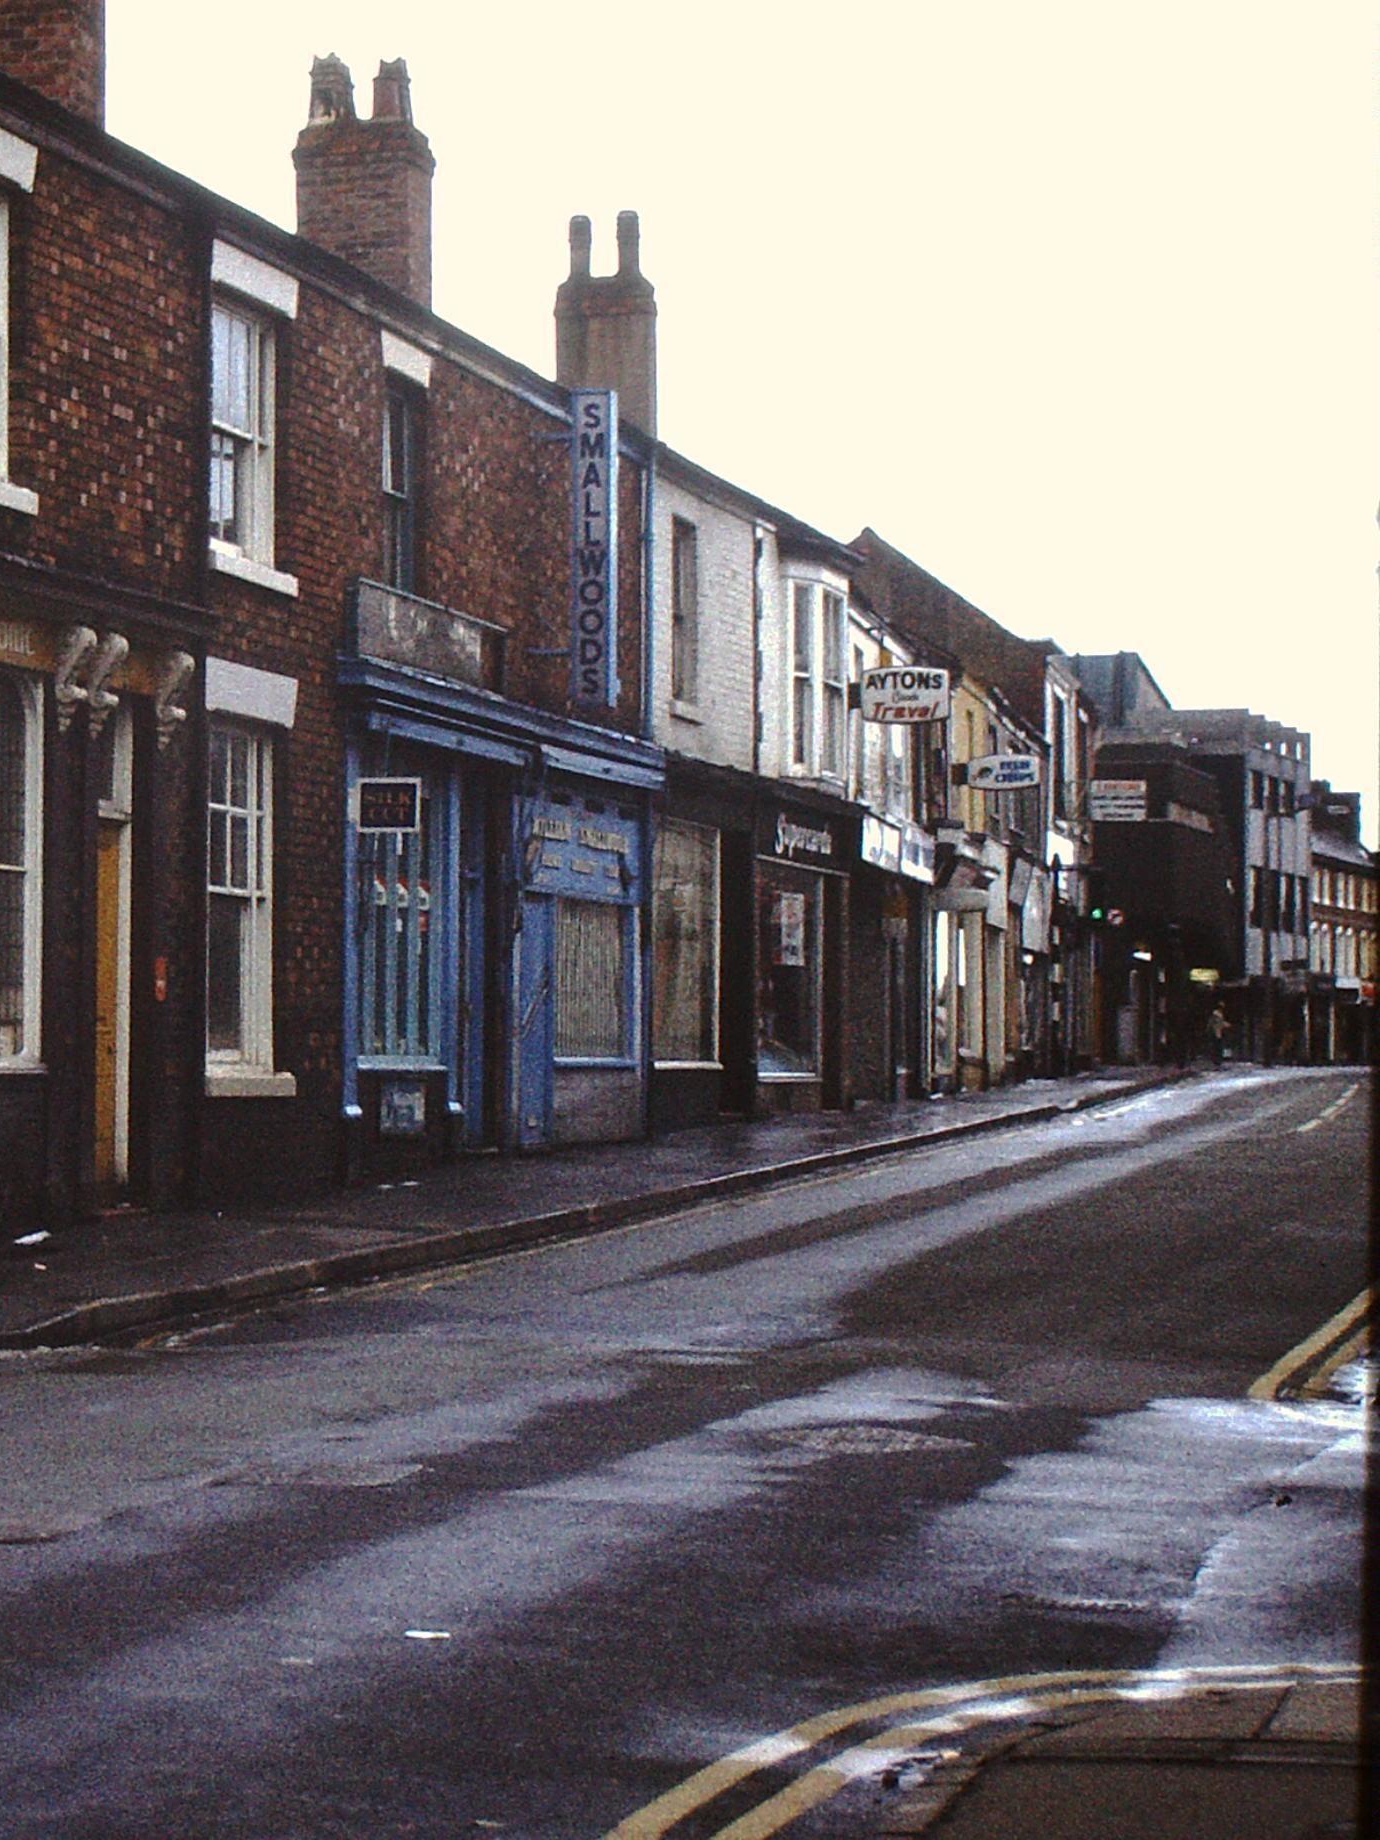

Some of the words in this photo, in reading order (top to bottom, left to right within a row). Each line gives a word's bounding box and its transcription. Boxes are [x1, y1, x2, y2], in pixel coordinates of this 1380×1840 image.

[579, 403, 605, 694] SMALLWOODS
[866, 671, 942, 690] AYTONS
[873, 701, 940, 720] Travel
